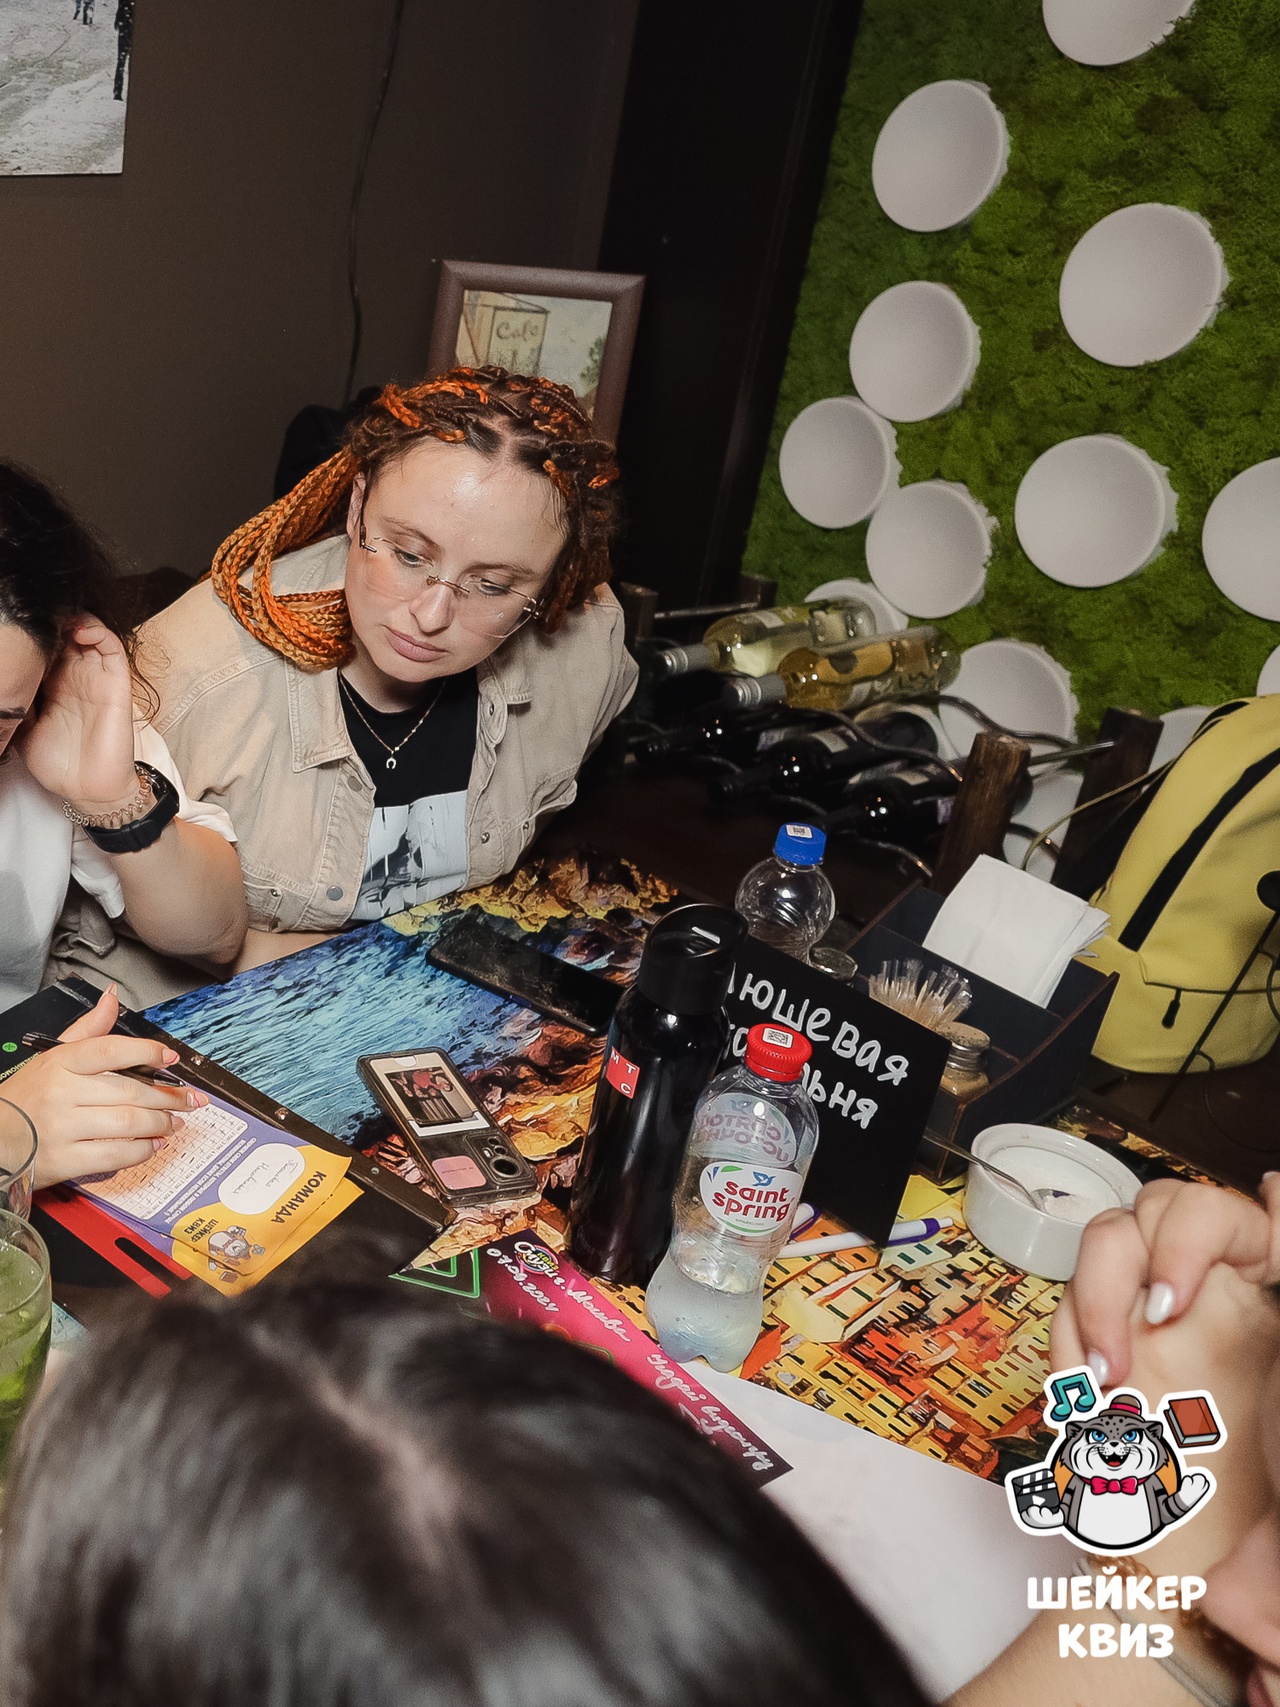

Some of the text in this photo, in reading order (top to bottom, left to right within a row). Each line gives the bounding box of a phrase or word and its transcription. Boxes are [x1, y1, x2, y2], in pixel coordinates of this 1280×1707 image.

[271, 1171, 328, 1225] КОМАНДА
[712, 1192, 792, 1222] spring
[725, 1181, 790, 1204] saint
[183, 1217, 206, 1236] КВИЗ
[191, 1218, 219, 1243] ШЕЙКЕР
[567, 1286, 631, 1342] Москва
[646, 1353, 708, 1402] Угадай
